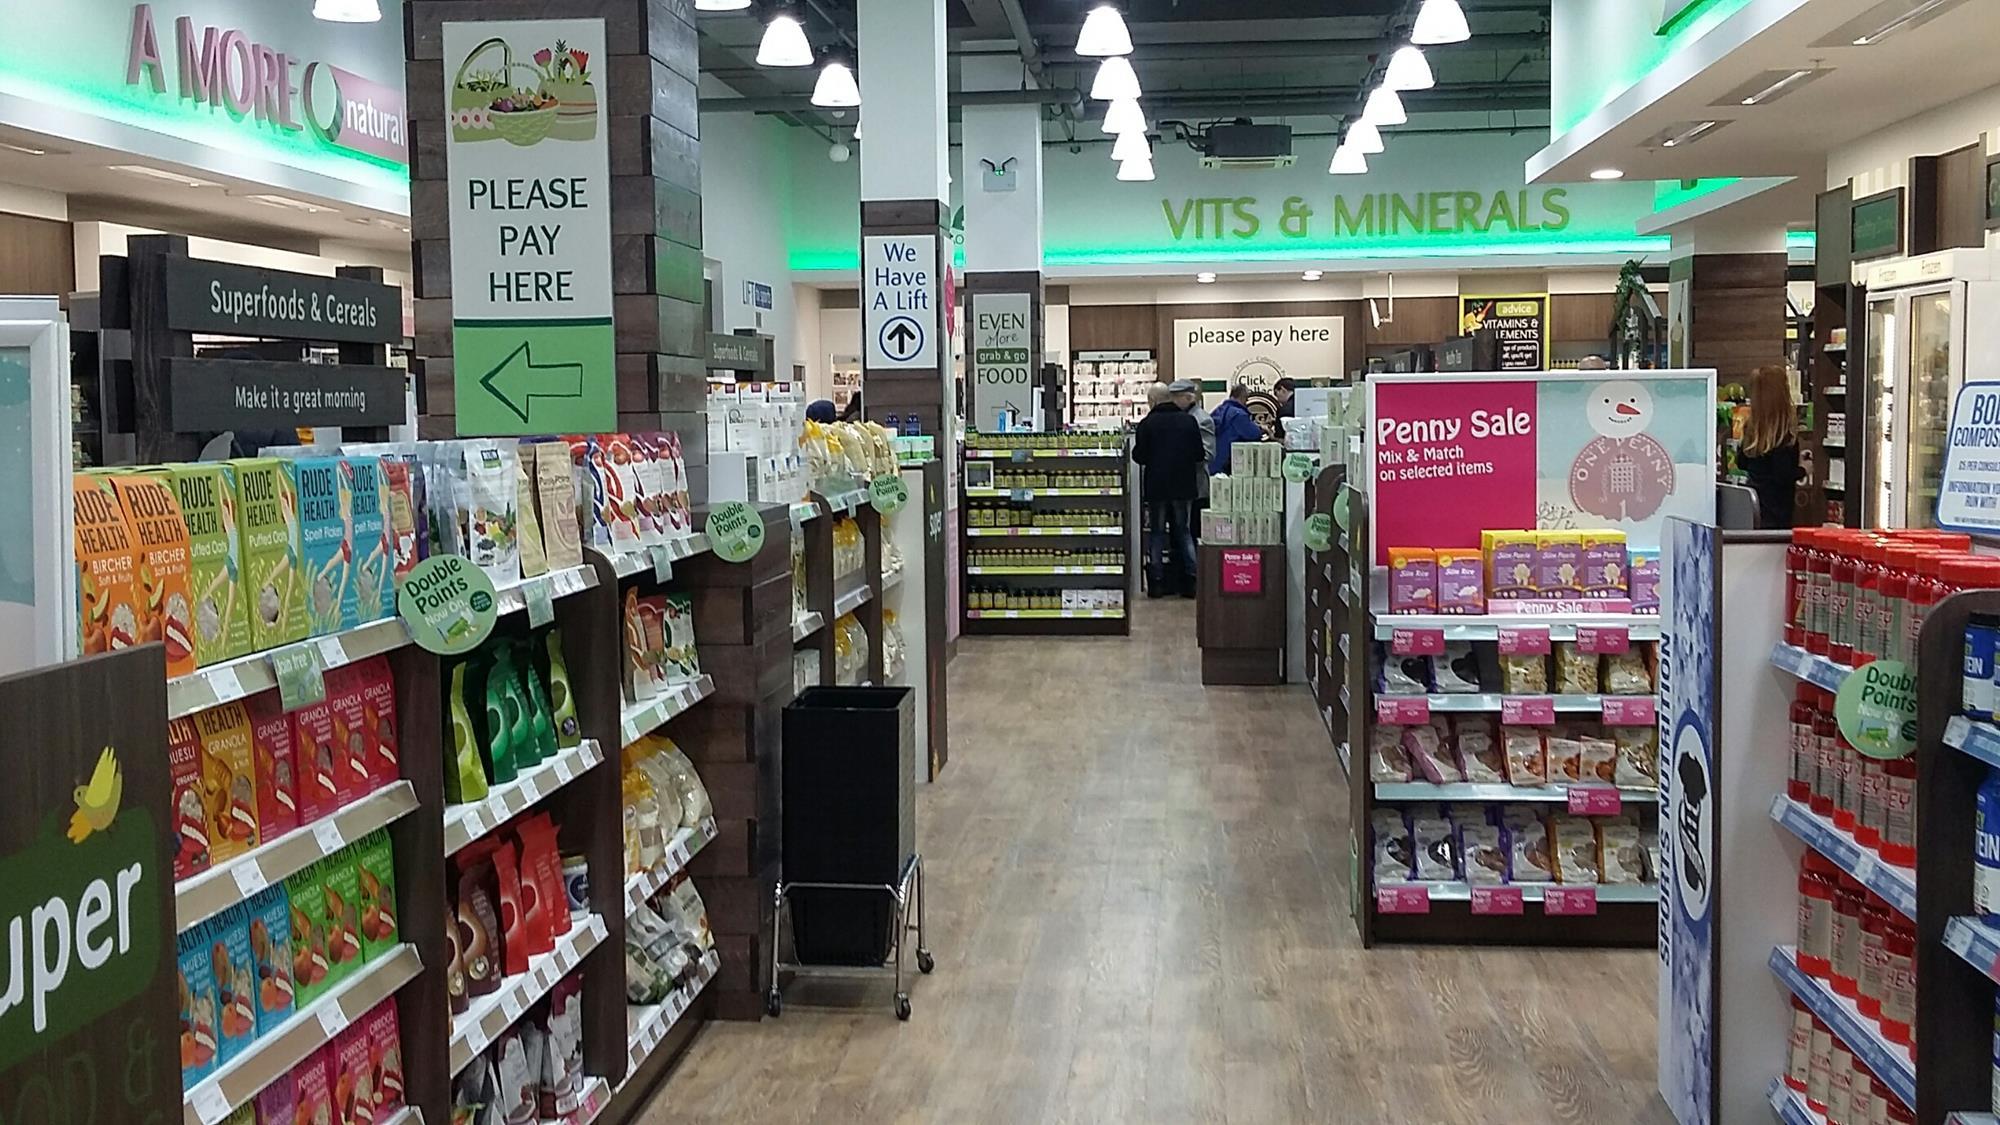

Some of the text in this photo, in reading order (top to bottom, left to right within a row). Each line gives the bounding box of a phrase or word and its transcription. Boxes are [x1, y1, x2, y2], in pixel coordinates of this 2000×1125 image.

[126, 4, 167, 93] A
[345, 98, 405, 147] natural
[469, 178, 588, 210] PLEASE
[1161, 187, 1571, 240] VITS & MINERALS
[500, 225, 561, 256] PAY
[883, 243, 917, 262] We
[490, 271, 574, 302] HERE
[875, 267, 926, 287] Have
[210, 280, 377, 328] Superfoods & Cereals
[873, 289, 928, 310] A Lift
[1502, 303, 1532, 314] advice
[979, 313, 1025, 330] EVEN
[1483, 318, 1539, 330] VITAMINS &
[1188, 325, 1330, 348] please pay here
[979, 351, 1026, 362] grab & go
[977, 367, 1028, 385] FOOD
[1238, 375, 1266, 386] Click
[235, 384, 366, 414] Make it a great morning
[1377, 407, 1531, 446] Penny Sale
[1953, 426, 2000, 448] COMPOS
[1378, 443, 1464, 465] Mix & Match
[1379, 460, 1494, 482] on selected items
[179, 475, 215, 510] RUDE
[242, 469, 274, 502] RUDE
[301, 468, 333, 499] RUDE
[874, 476, 898, 490] Double
[875, 486, 899, 497] Points
[125, 483, 176, 519] RUDE
[303, 500, 335, 522] HEALTH
[246, 503, 278, 528] HEALTH
[710, 502, 744, 527] Double
[136, 518, 184, 546] HEALTH
[355, 522, 368, 534] pelt
[716, 516, 747, 537] Points
[78, 524, 130, 554] HEALTH
[149, 547, 186, 565] BIRCHER
[191, 544, 212, 557] uffed
[92, 555, 133, 574] BIRCHER
[404, 557, 462, 598] Double
[415, 576, 469, 616] Points
[1516, 599, 1583, 614] Penny Sale
[1866, 666, 1918, 692] Doubl
[364, 682, 391, 700] GRANOLA
[1862, 685, 1917, 712] Points
[333, 693, 362, 712] GRANOLA
[202, 704, 244, 736] HEALTH
[299, 705, 330, 725] GRANOLA
[257, 719, 288, 740] GRANOLA
[208, 733, 247, 754] GRANOLA
[1660, 631, 1672, 966] SPORTS NUTRITION
